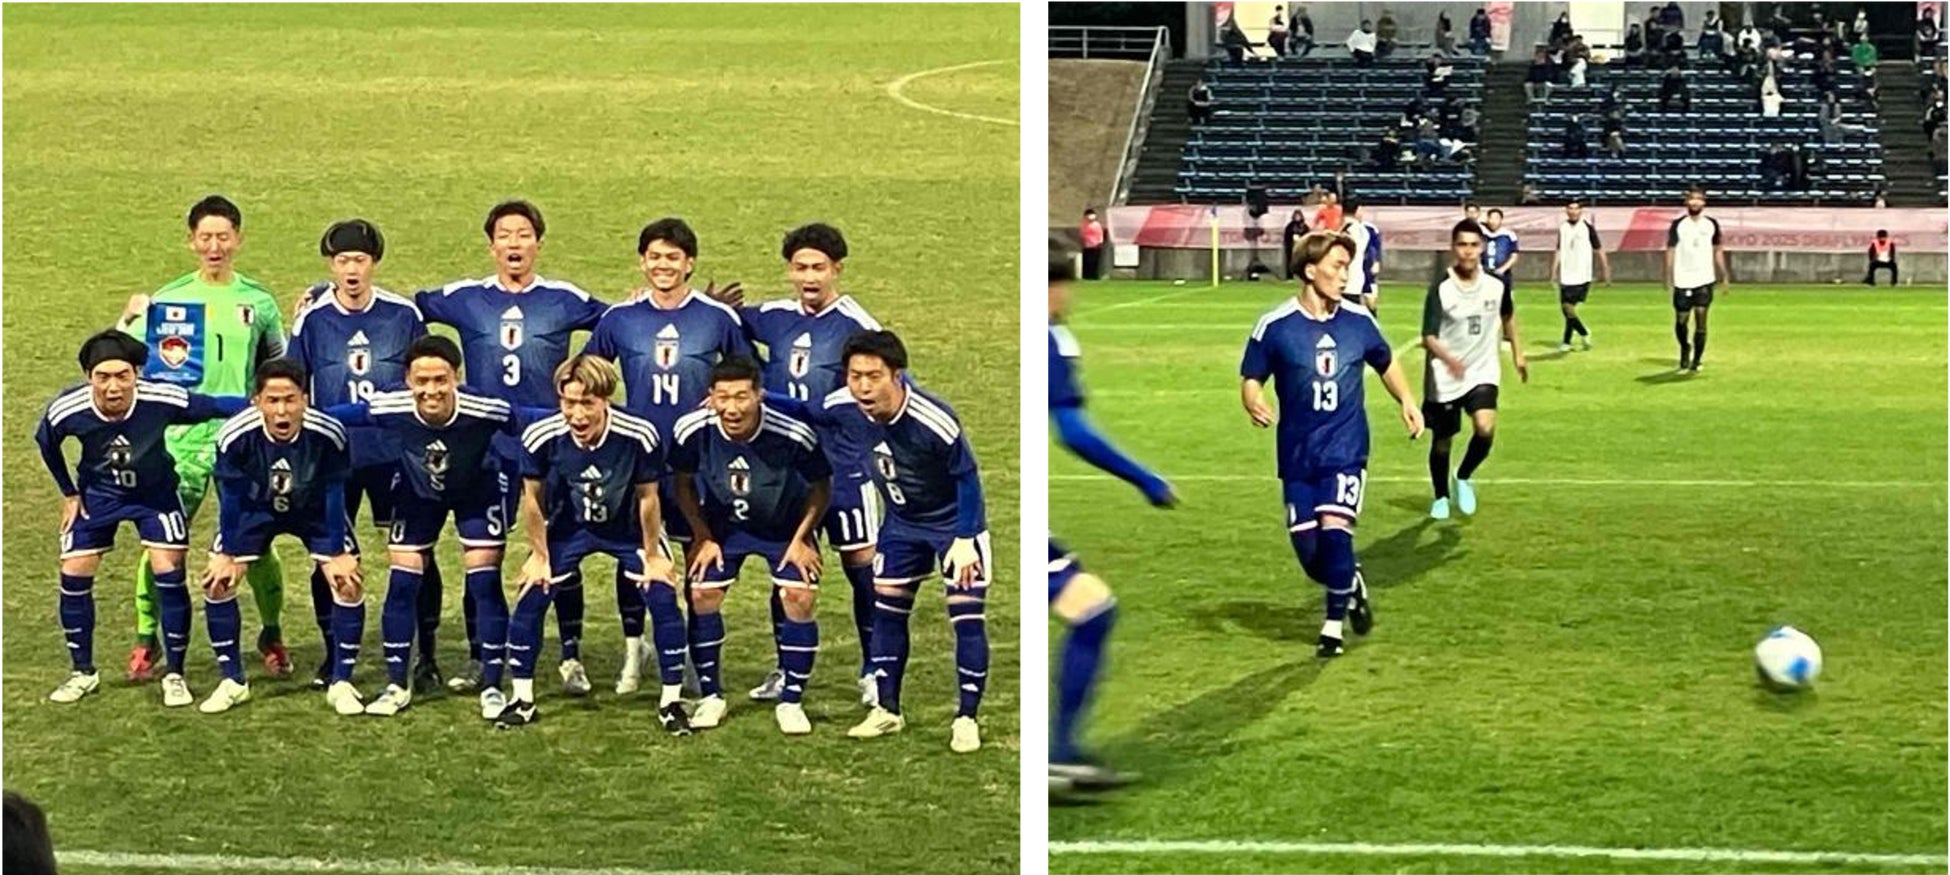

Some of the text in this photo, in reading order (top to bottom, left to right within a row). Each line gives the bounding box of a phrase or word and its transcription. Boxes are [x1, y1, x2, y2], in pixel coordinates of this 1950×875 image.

[215, 333, 223, 362] 1
[502, 354, 520, 386] 3
[652, 373, 679, 405] 14
[1312, 380, 1338, 412] 13
[111, 468, 137, 487] 10
[1336, 472, 1361, 506] 13
[273, 496, 289, 512] 6
[582, 496, 607, 522] 13
[733, 499, 749, 520] 2
[158, 511, 186, 542] 10
[486, 505, 502, 536] 5
[838, 508, 864, 541] 11
